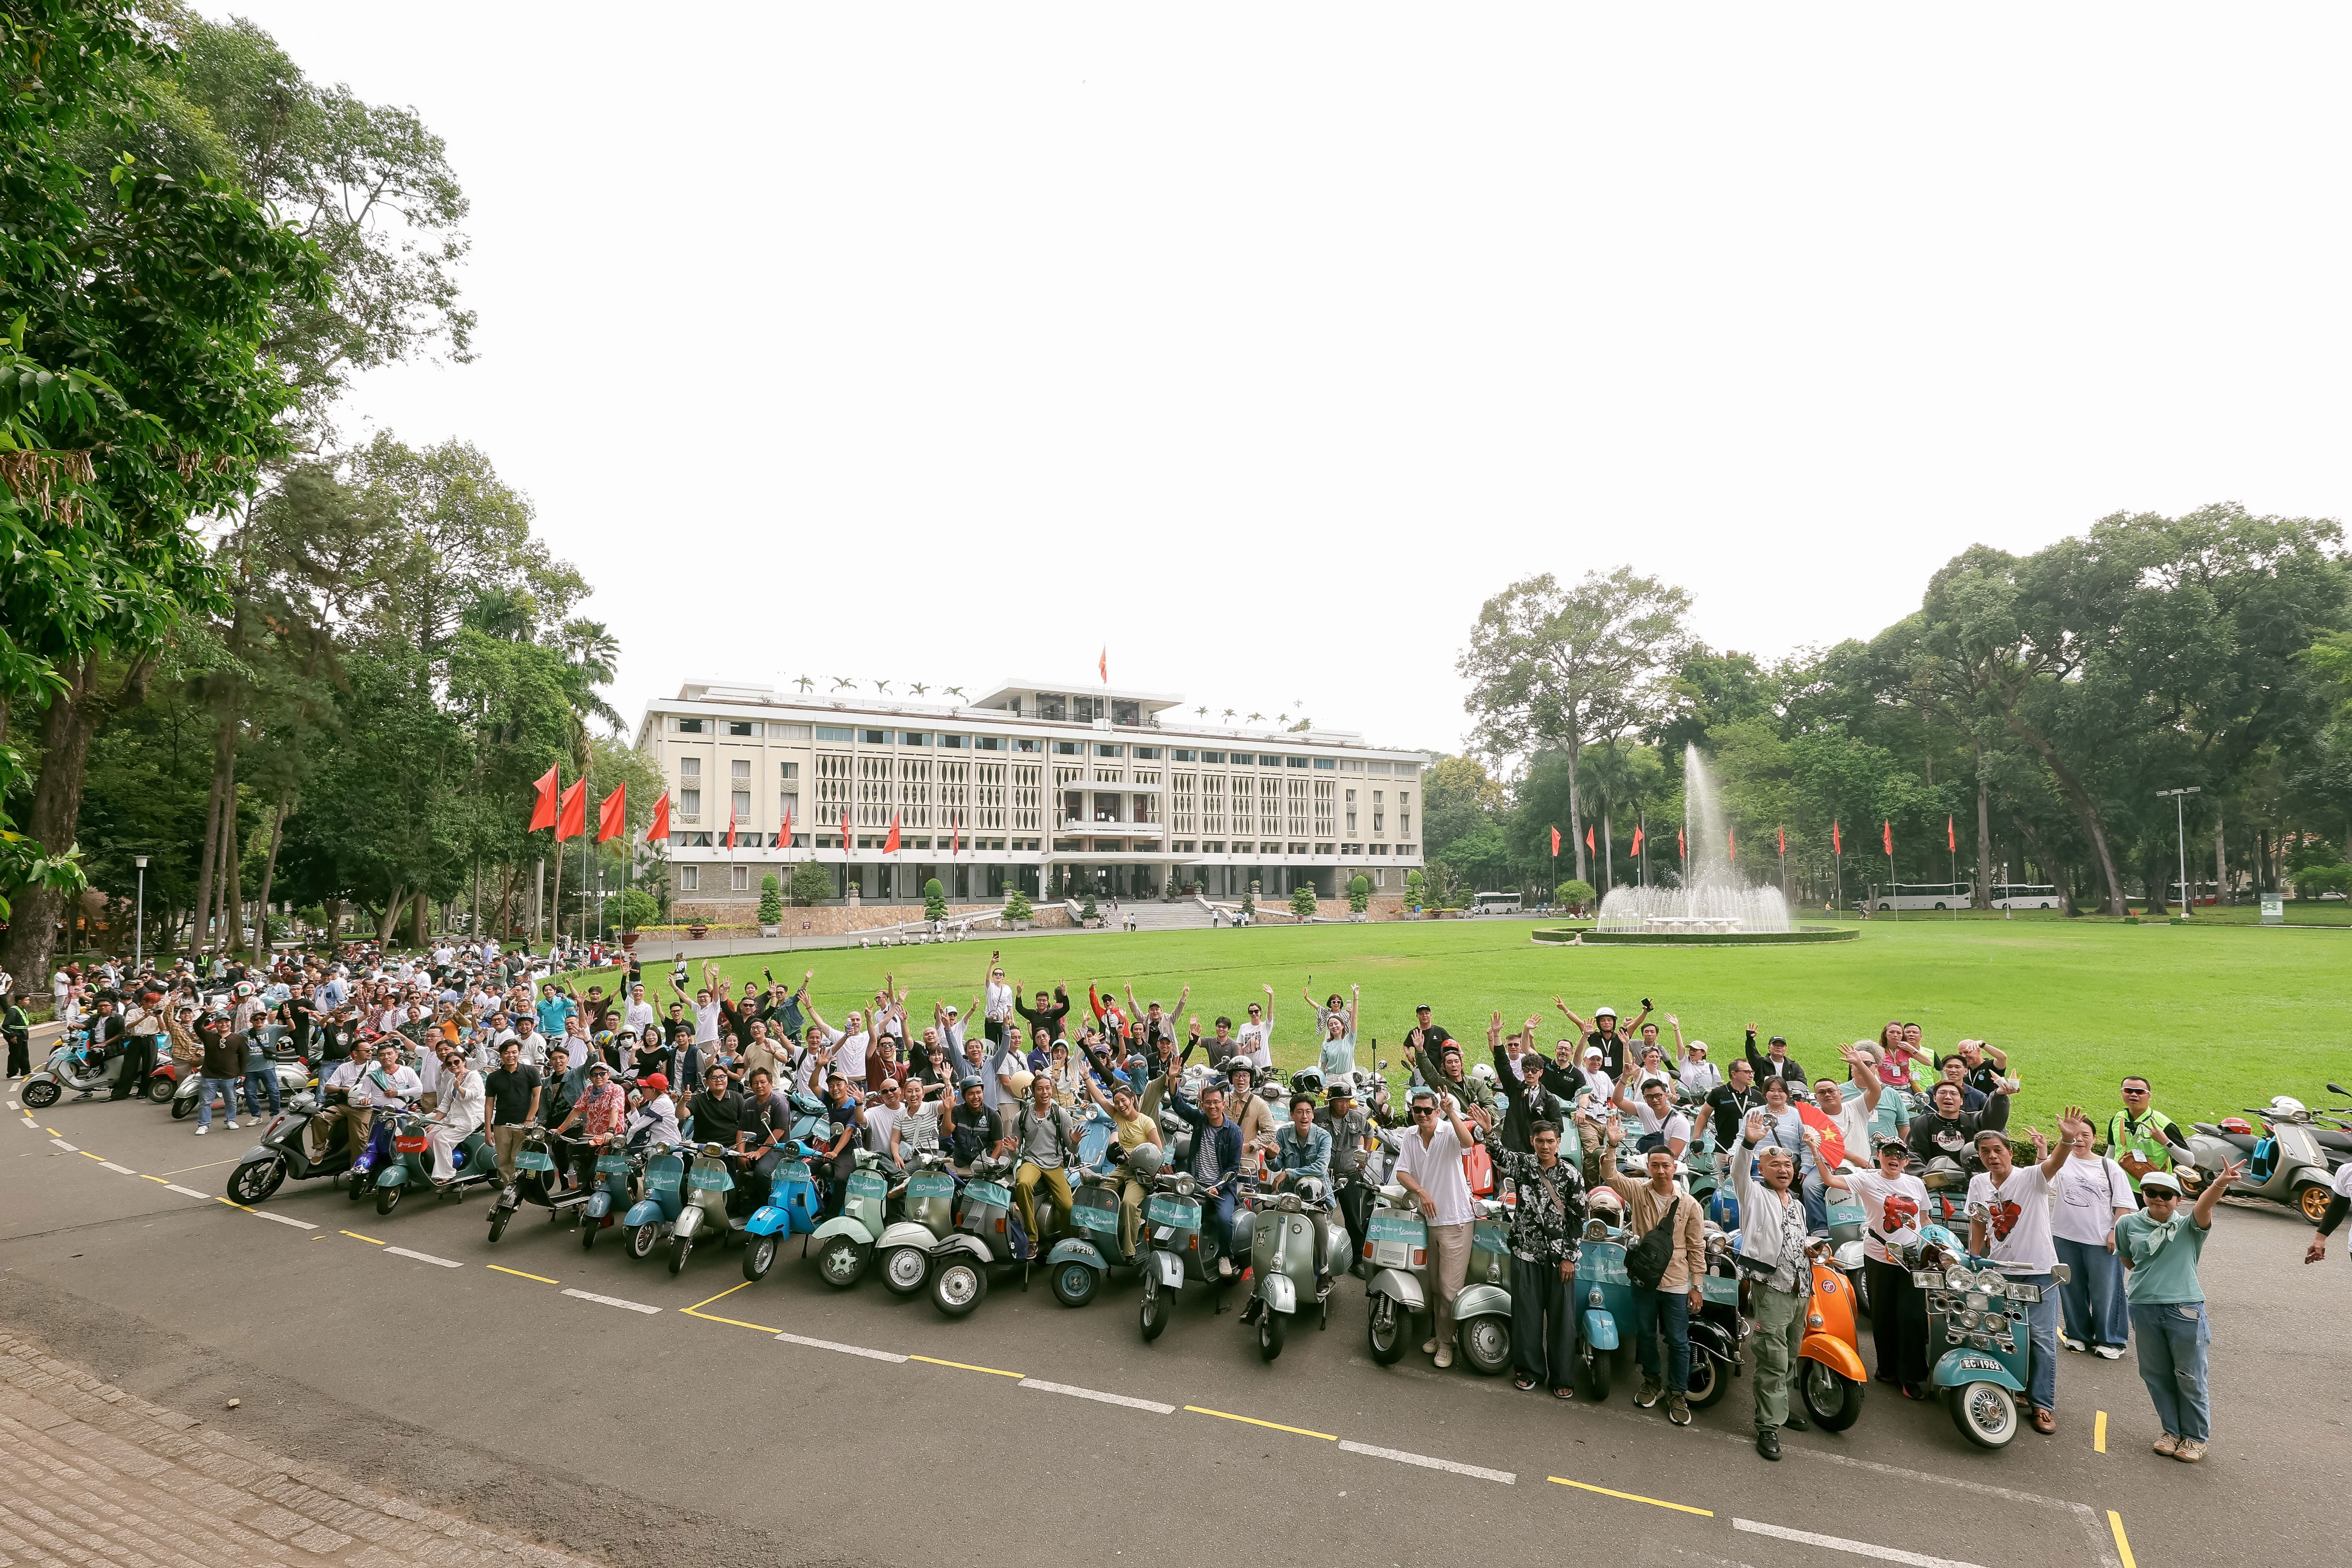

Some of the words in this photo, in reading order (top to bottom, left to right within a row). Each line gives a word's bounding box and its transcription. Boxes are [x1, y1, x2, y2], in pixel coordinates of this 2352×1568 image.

[1829, 1197, 1848, 1206] Vespa
[1095, 1216, 1114, 1224] Vespa
[1399, 1226, 1423, 1235] Vespa
[1706, 1282, 1736, 1294] Vespa
[1963, 1359, 1976, 1368] EC
[1980, 1360, 2000, 1370] 1962
